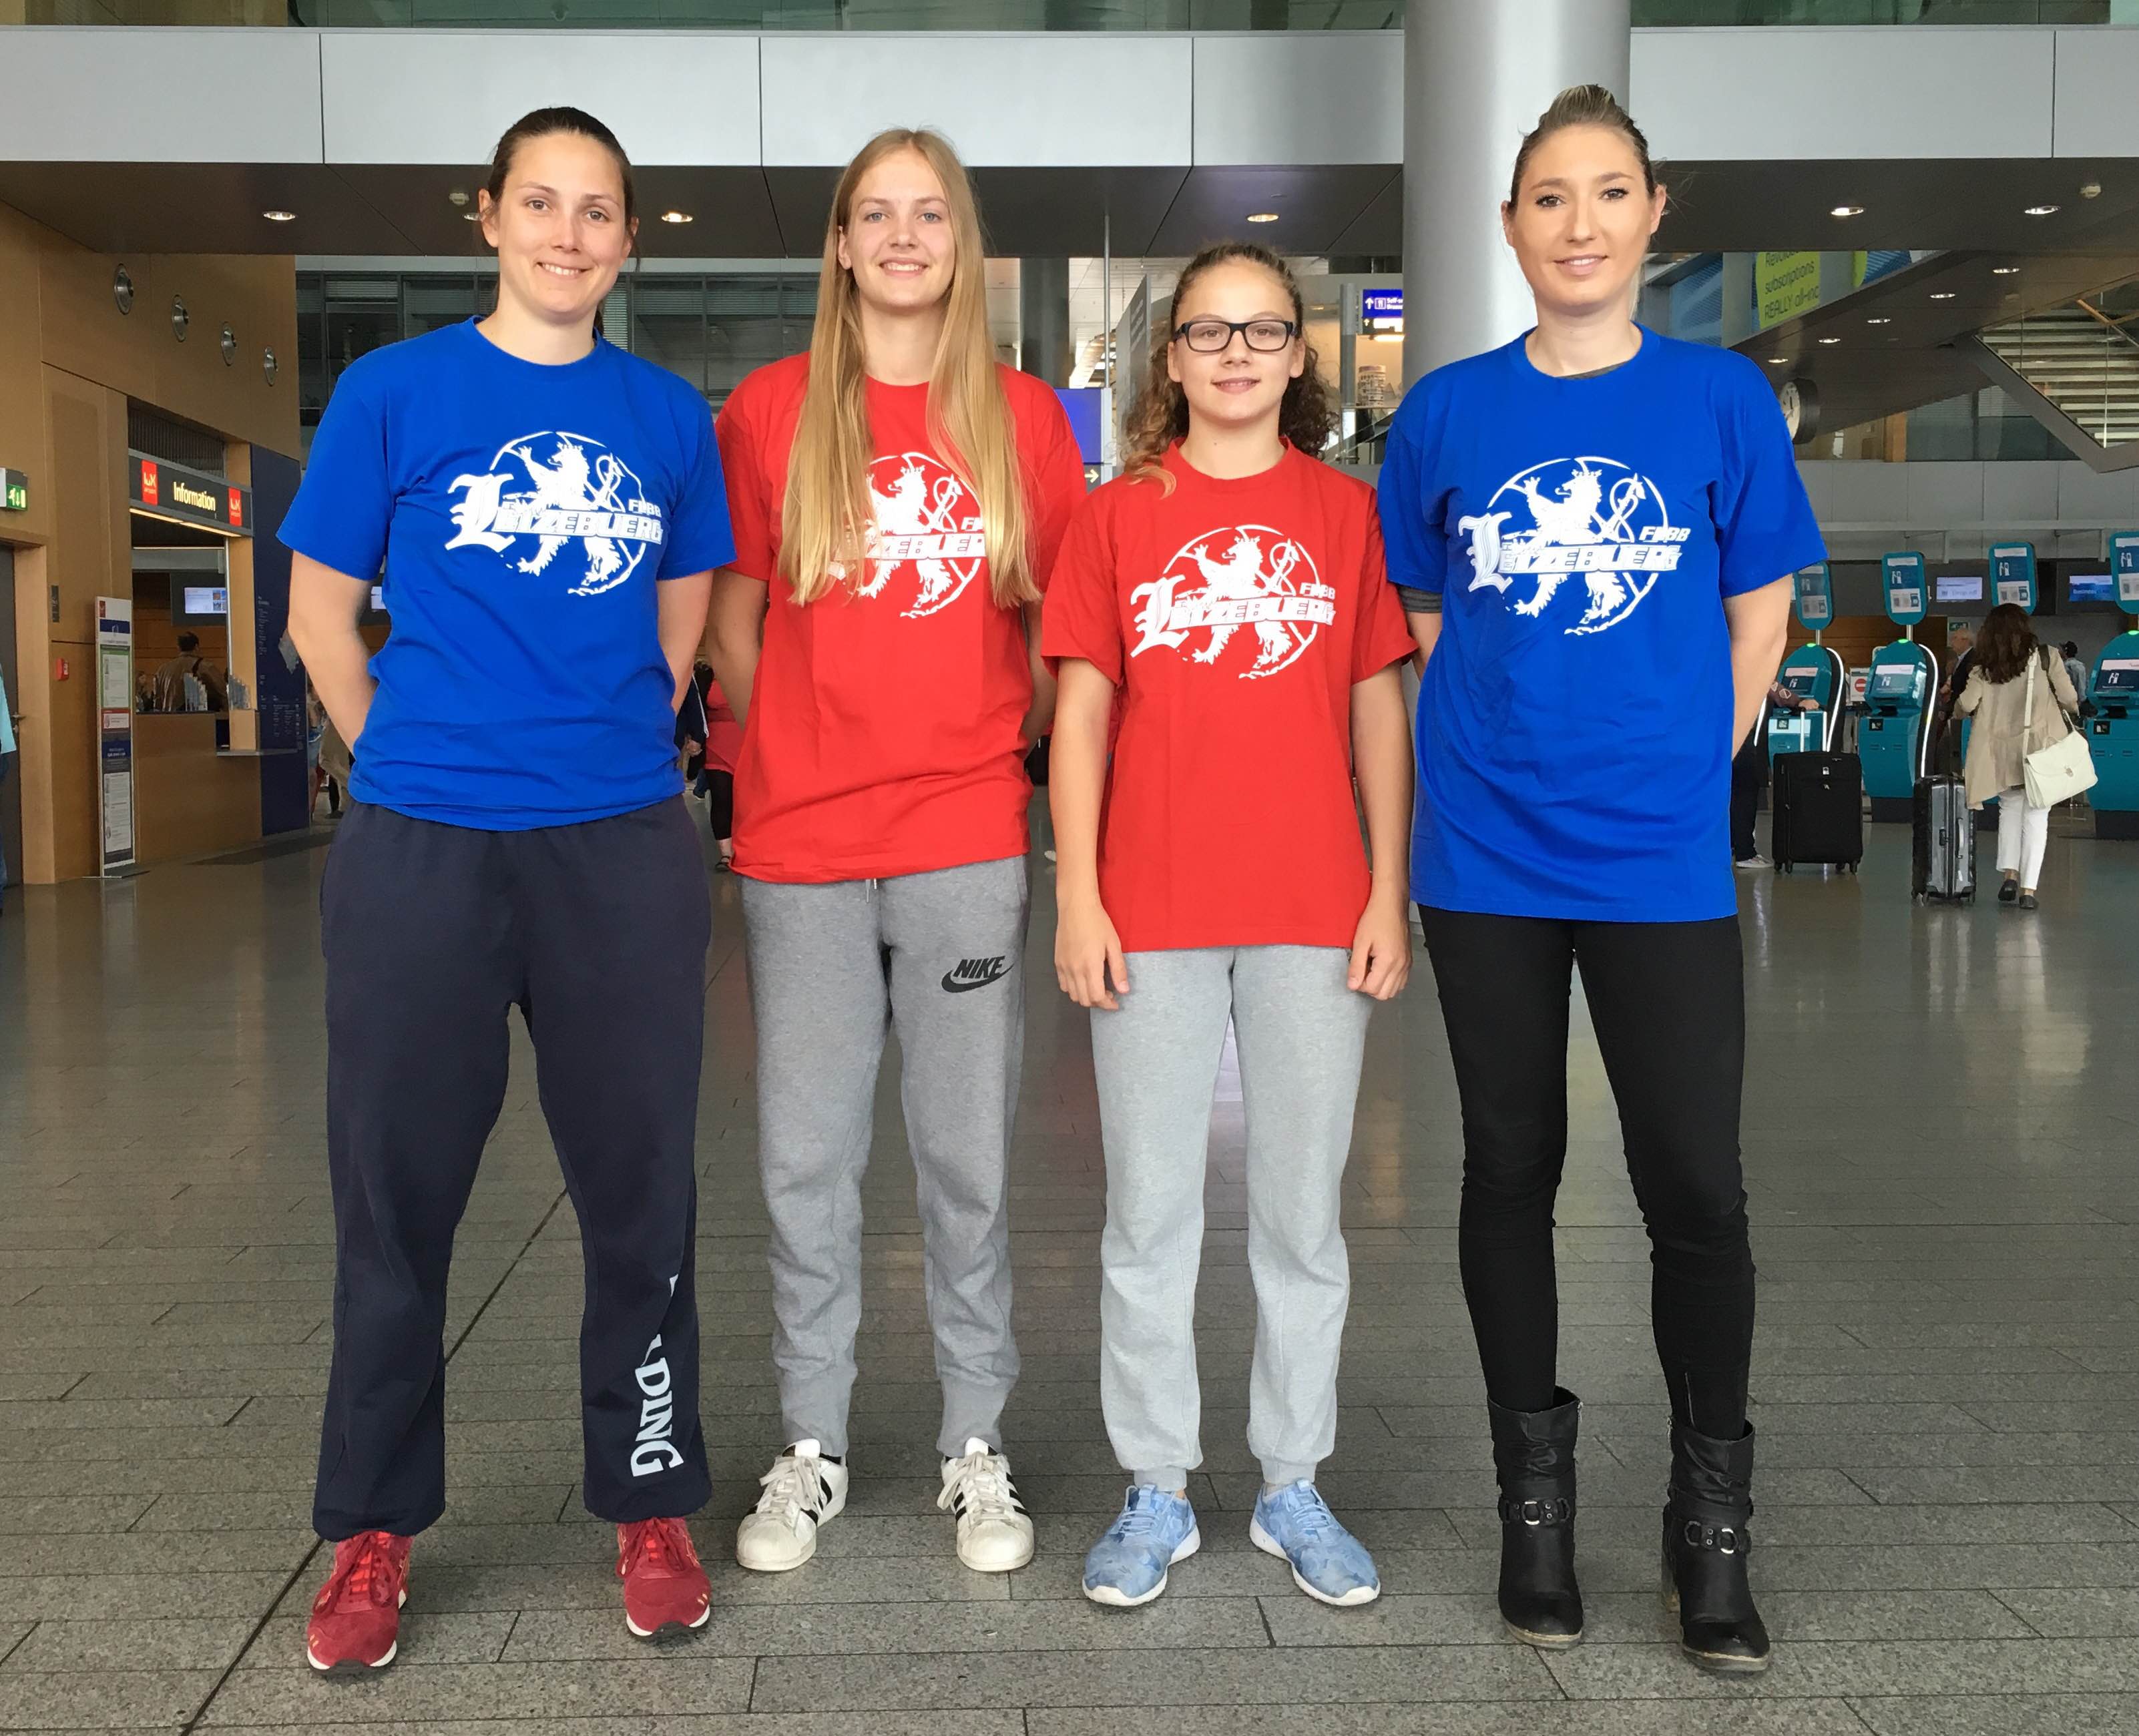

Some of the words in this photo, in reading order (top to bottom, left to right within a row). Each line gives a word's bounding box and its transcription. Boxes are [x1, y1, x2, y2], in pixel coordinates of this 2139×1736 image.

[1764, 260, 1815, 295] subscriptions
[1764, 294, 1794, 321] REALLY
[173, 481, 216, 511] Information
[953, 955, 1006, 979] NIKE
[630, 1335, 684, 1477] DING
